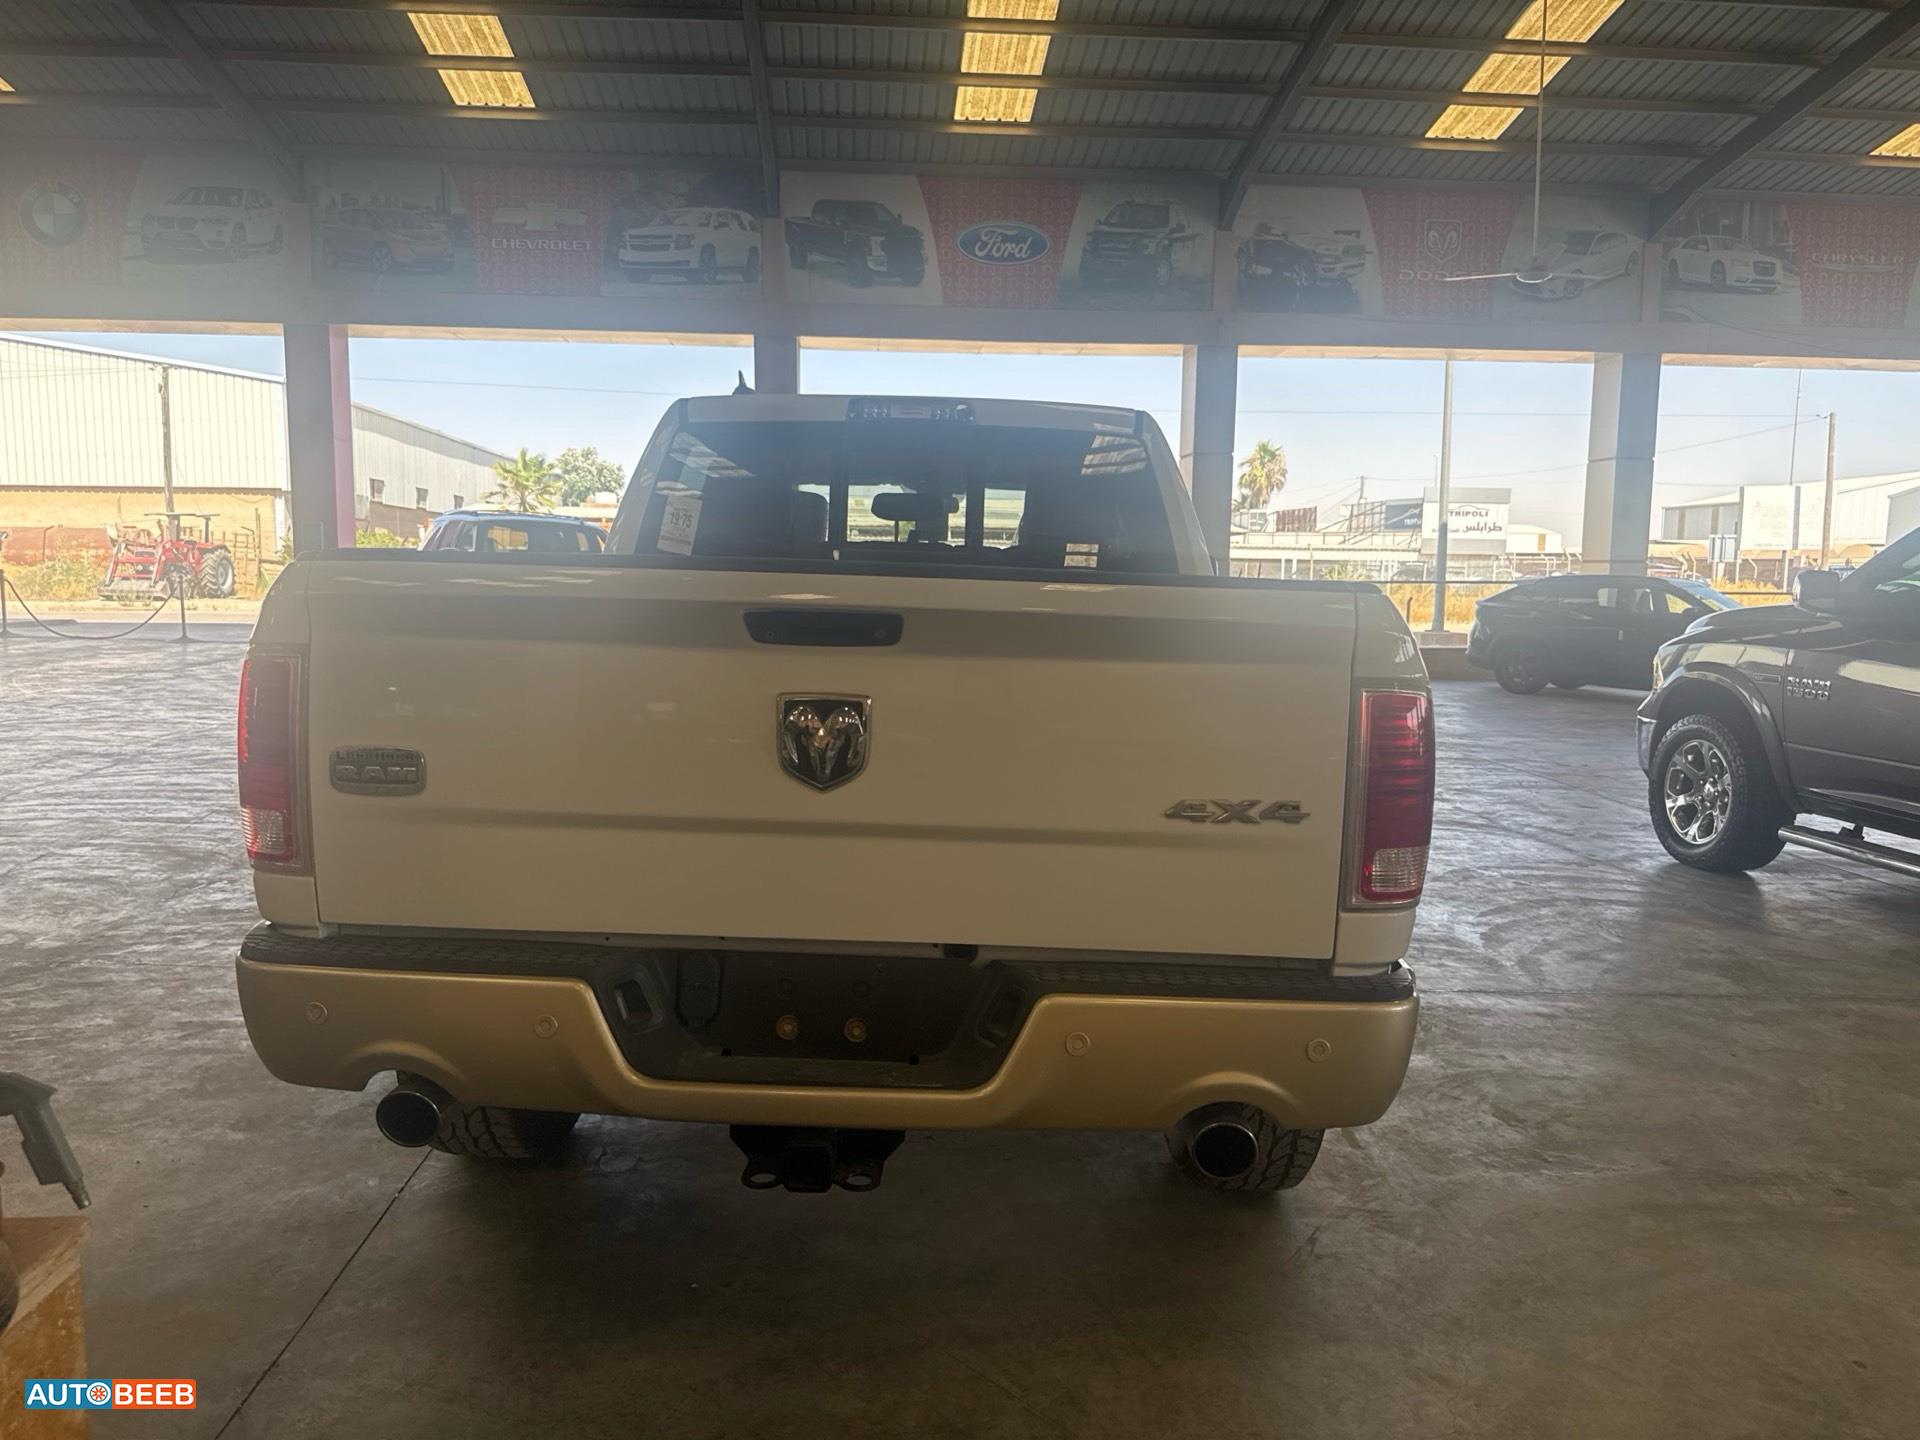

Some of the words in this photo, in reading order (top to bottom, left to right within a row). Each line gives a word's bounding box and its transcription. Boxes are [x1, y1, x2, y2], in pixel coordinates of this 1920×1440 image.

[491, 238, 592, 250] CHEVROLET
[974, 226, 1032, 258] Ford
[1811, 253, 1904, 265] CHRYSLER
[1449, 510, 1490, 518] TRIPOLI
[1462, 521, 1503, 534] طرابلس
[1787, 676, 1830, 689] RAM
[1786, 686, 1830, 700] 1500
[335, 765, 417, 782] RAM
